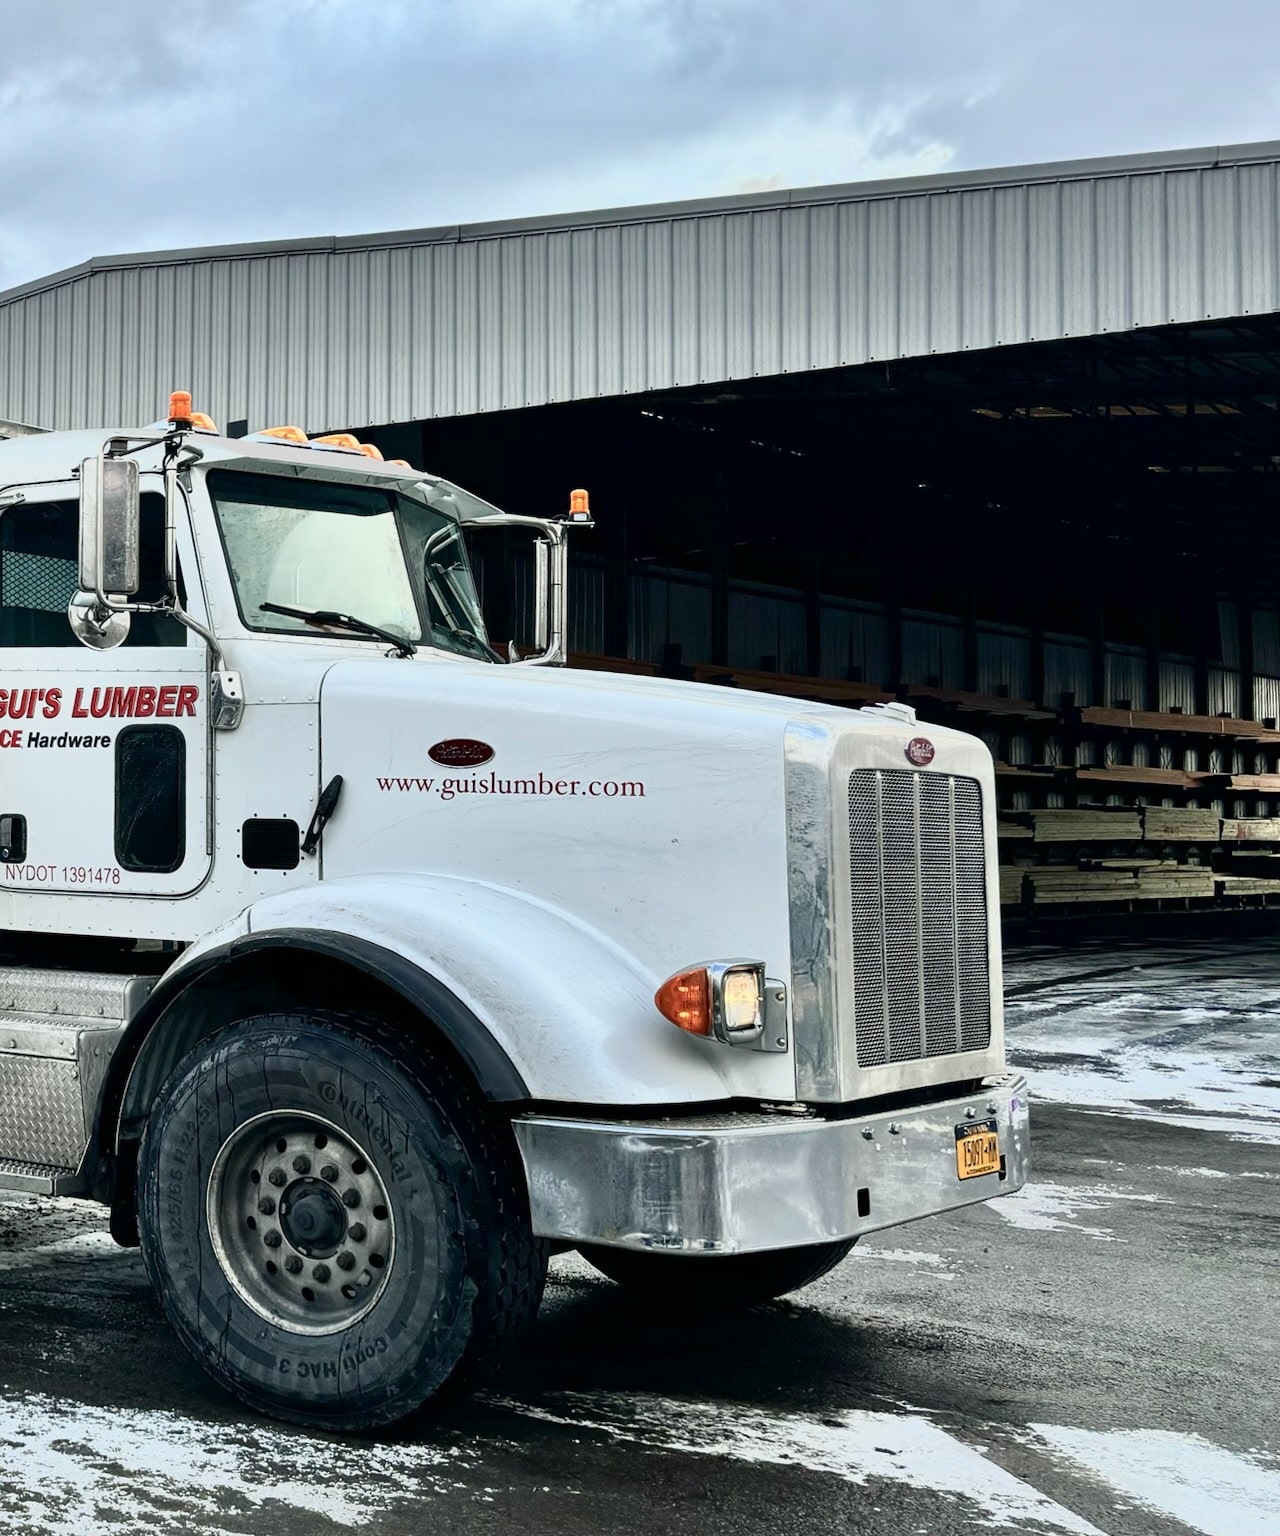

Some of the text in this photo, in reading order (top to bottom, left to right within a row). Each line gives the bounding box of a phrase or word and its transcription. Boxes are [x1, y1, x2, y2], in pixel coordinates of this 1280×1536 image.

[71, 685, 200, 719] LUMBER
[27, 731, 111, 749] Hardware
[376, 772, 647, 800] www.guislumber.com
[5, 864, 121, 885] NYDOT 1391478
[279, 1358, 291, 1374] 3
[296, 1361, 337, 1379] HAC
